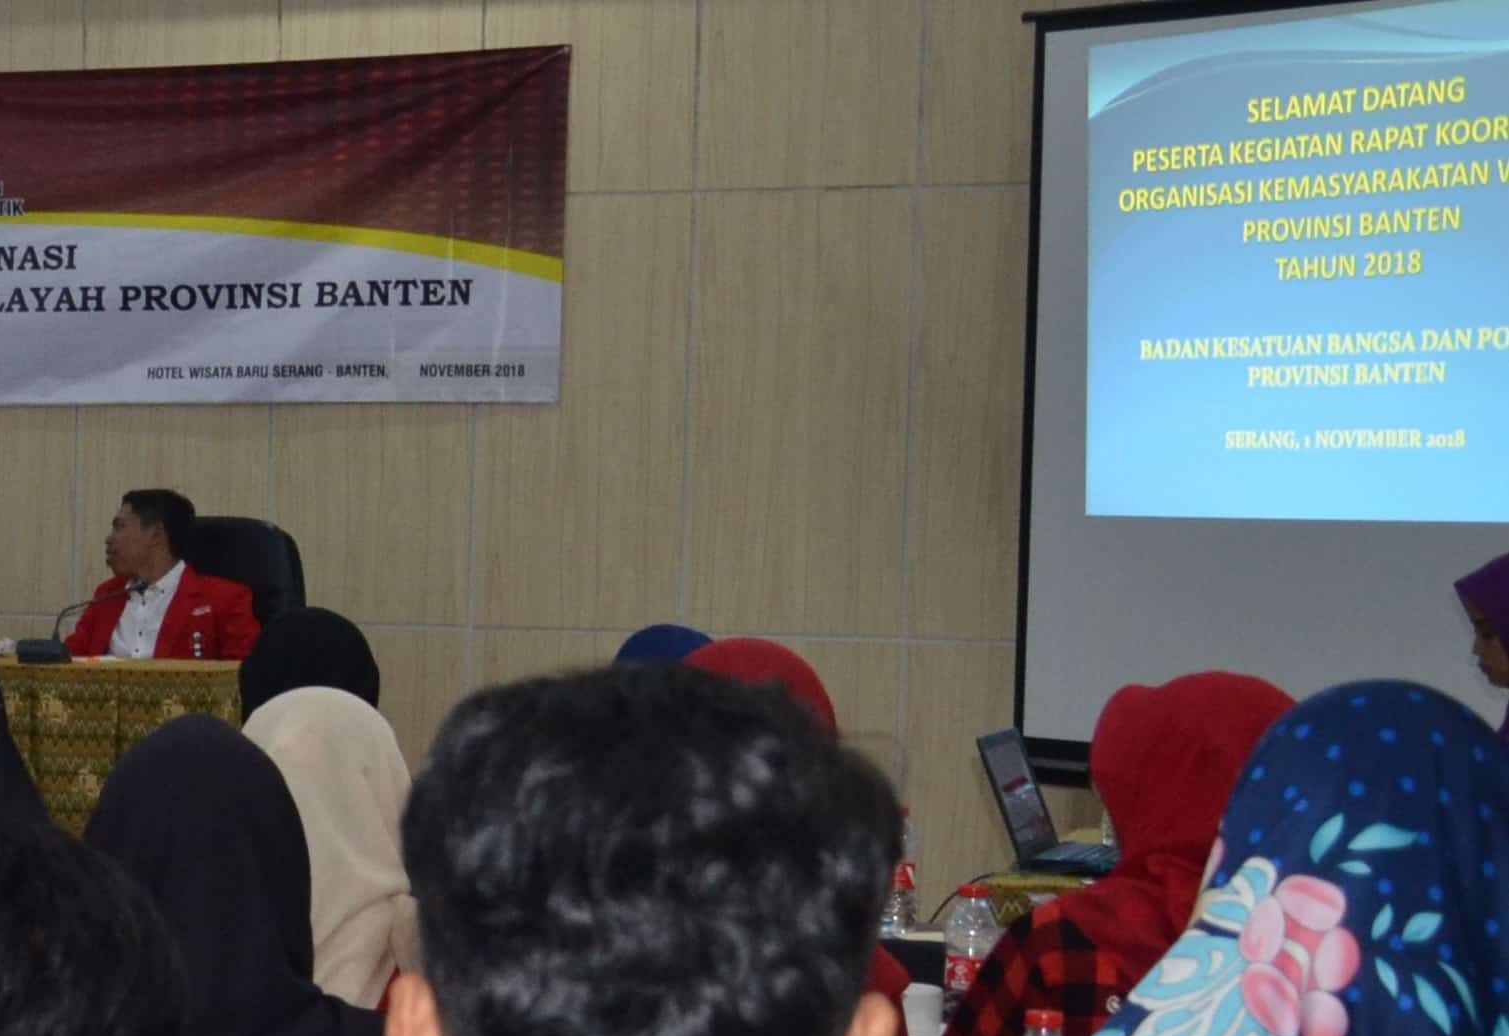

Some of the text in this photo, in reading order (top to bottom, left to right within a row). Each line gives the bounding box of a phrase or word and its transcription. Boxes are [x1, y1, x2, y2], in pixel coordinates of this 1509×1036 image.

[1247, 76, 1466, 124] SELAMAT DATANG
[1132, 143, 1223, 173] PESERTA
[1230, 133, 1342, 165] KEGIATAN
[1350, 123, 1428, 154] RAPAT
[1119, 184, 1253, 213] ORGANISASI
[1259, 160, 1490, 203] KEMASYARAKATAN
[1243, 206, 1462, 244] PROVINSI BANTEN
[1276, 249, 1422, 281] TAHUN 2018
[119, 282, 302, 312] PROVINSI
[316, 279, 474, 307] BANTEN
[1140, 338, 1209, 361] BADAN
[1212, 333, 1322, 359] KESATUAN
[1327, 330, 1416, 355] BANGSA
[1421, 328, 1473, 352] DAN
[147, 366, 184, 381] HOTEL
[189, 365, 233, 381] WISATA
[236, 364, 269, 380] BARU
[272, 364, 323, 379] SERANG
[336, 363, 389, 381] BANTEN,
[420, 363, 491, 379] NOVEMBER
[494, 363, 526, 379] 2018
[1247, 360, 1447, 388] PROVINSI BANTEN
[1225, 430, 1300, 452] SERANG,
[1315, 429, 1423, 450] NOVEMBER
[1426, 430, 1467, 449] 2018
